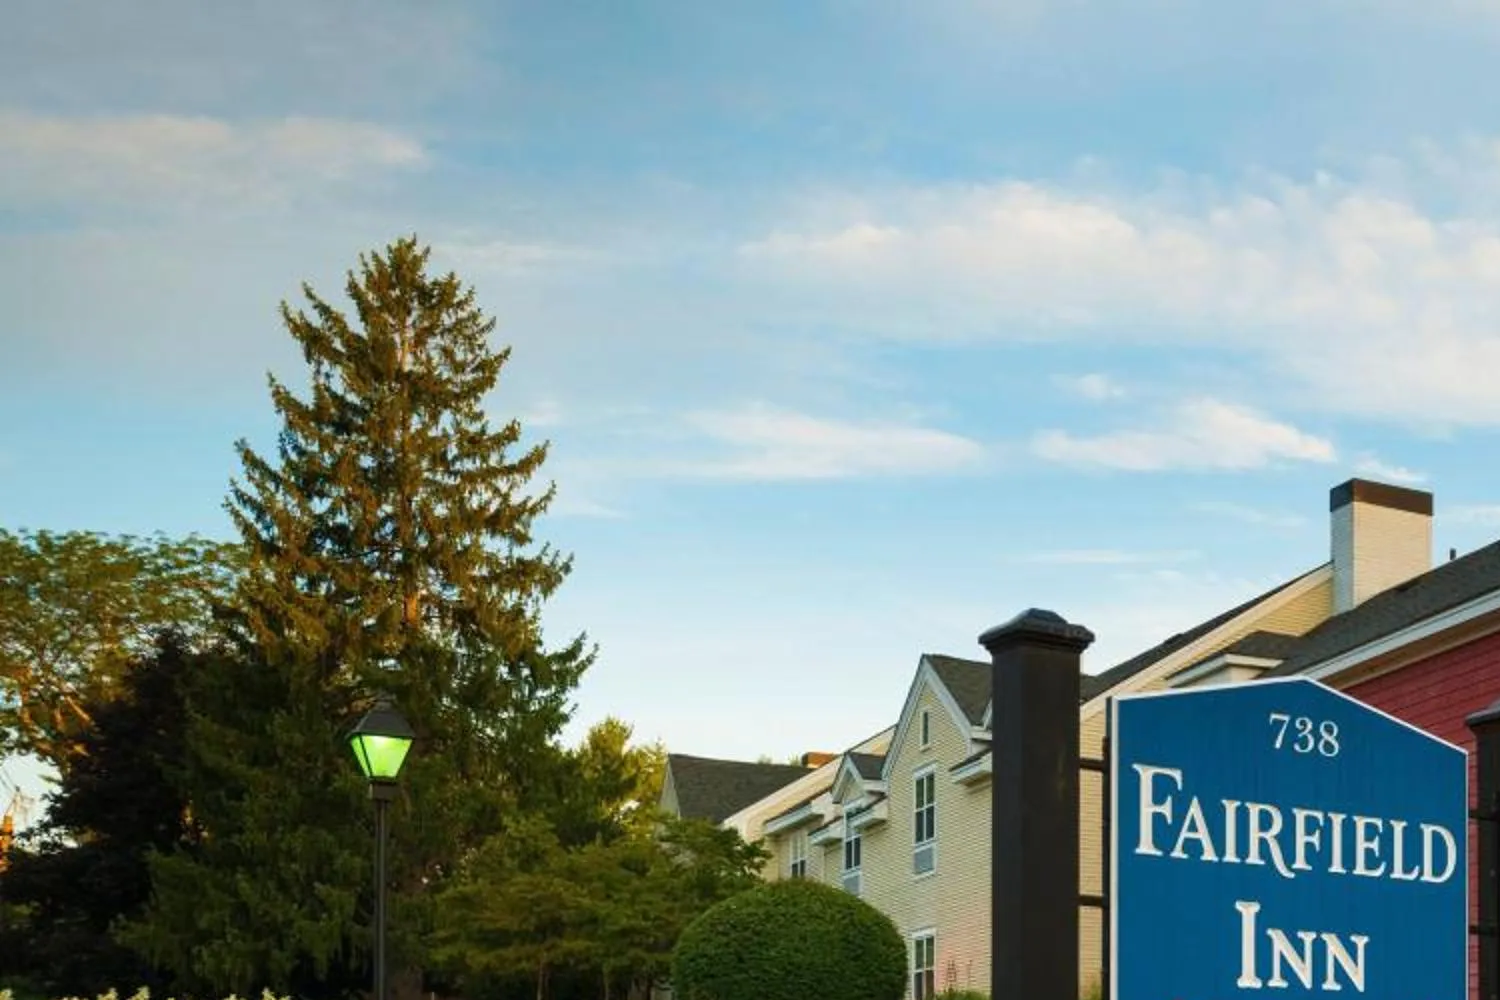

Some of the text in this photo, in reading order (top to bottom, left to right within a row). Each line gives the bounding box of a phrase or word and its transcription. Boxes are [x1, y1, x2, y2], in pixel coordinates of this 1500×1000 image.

[1268, 712, 1341, 758] 738
[1131, 762, 1458, 884] FAIRFIELD
[1234, 900, 1370, 993] INN
